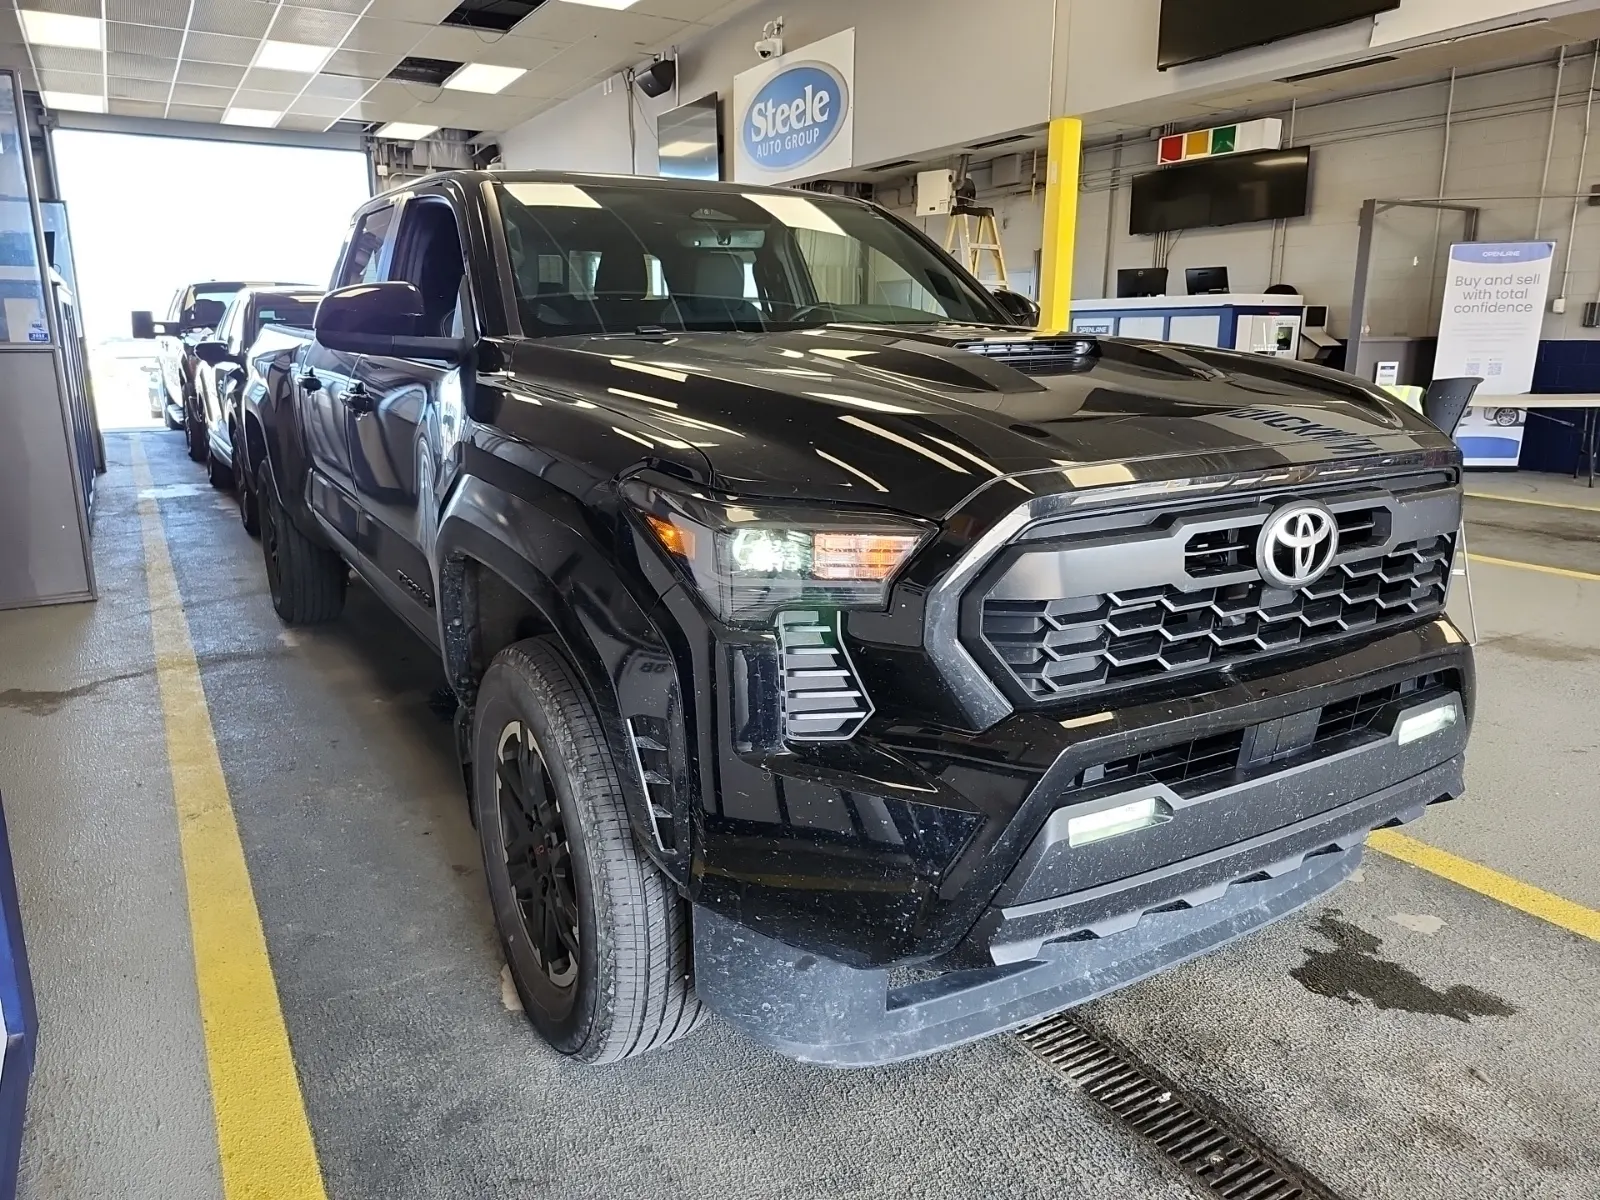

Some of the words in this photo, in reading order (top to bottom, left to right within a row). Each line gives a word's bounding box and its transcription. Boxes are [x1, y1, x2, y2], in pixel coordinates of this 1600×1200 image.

[751, 84, 831, 142] Steele
[756, 140, 782, 158] AUTO
[785, 127, 820, 150] GROUP
[1482, 250, 1520, 258] OPENLANE
[1455, 275, 1481, 289] Buy
[1484, 273, 1513, 285] and
[1516, 273, 1540, 285] sell
[1463, 288, 1492, 300] with
[1496, 288, 1528, 300] total
[1453, 301, 1533, 313] confidence
